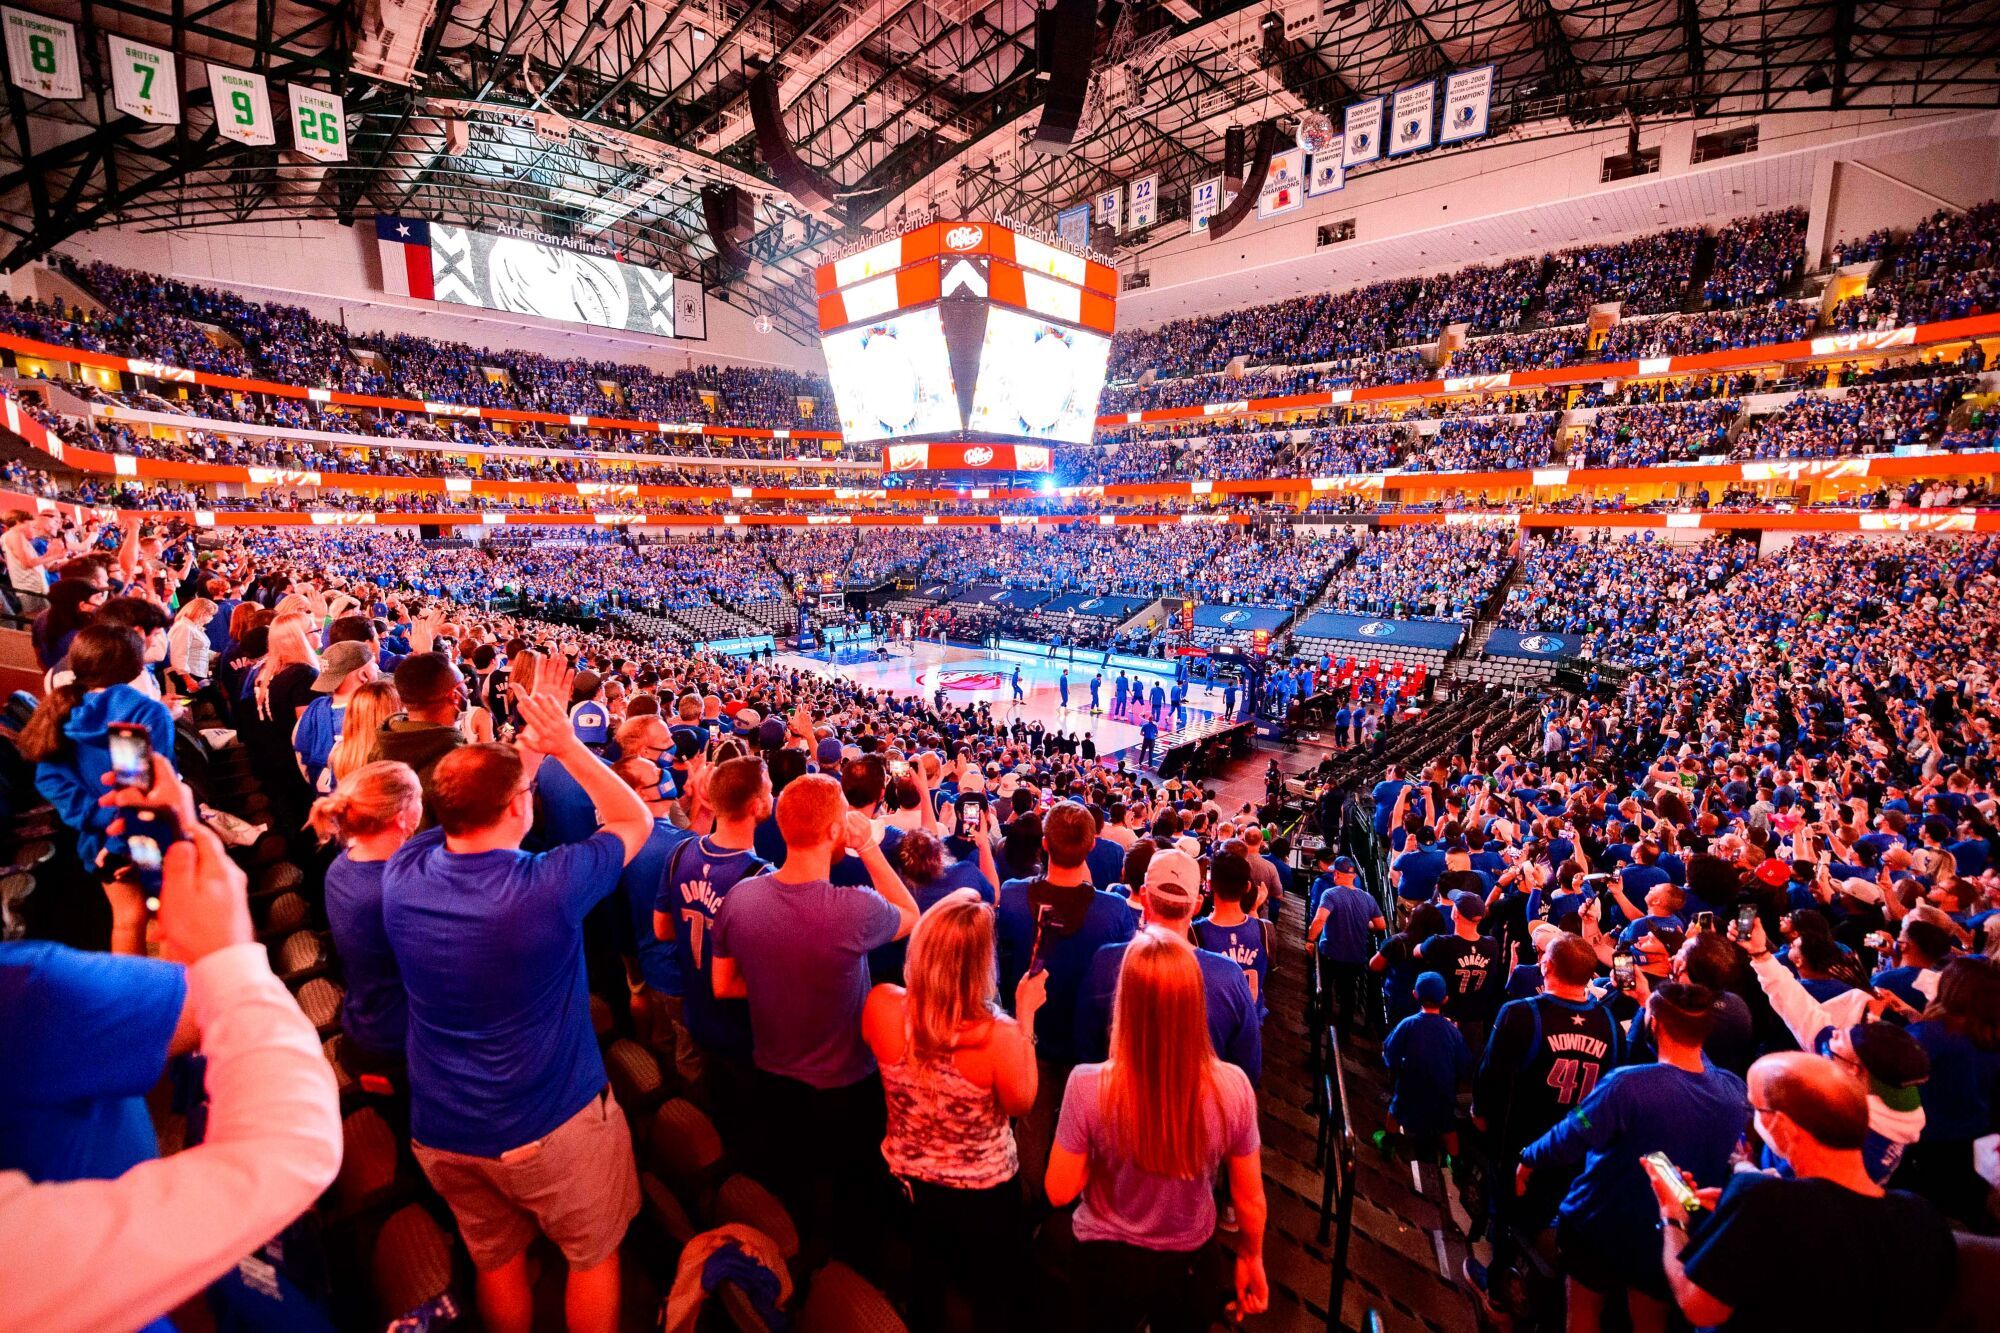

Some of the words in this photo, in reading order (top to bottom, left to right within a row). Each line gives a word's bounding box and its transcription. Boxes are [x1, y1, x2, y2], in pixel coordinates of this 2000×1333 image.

[29, 34, 57, 75] 8
[125, 47, 160, 64] BROTEN
[133, 62, 155, 100] 7
[222, 75, 254, 88] MODANO
[1453, 74, 1486, 89] 2005-2006
[300, 94, 333, 109] LEHTINEN
[1450, 89, 1485, 103] CHAMPIONS
[231, 91, 254, 126] 9
[1397, 104, 1428, 118] CHAMPIONS
[298, 106, 340, 145] 26
[1348, 119, 1377, 132] CHAMPIONS
[1315, 152, 1342, 163] CHAMPIONS
[1136, 180, 1151, 199] 22
[1198, 185, 1213, 201] 12
[1262, 180, 1300, 196] CHAMPIONS
[1102, 194, 1115, 211] 15
[497, 221, 560, 246] American
[561, 235, 608, 256] Airlines
[816, 241, 861, 267] American
[860, 226, 897, 250] Airlines
[895, 207, 937, 236] Center
[994, 208, 1049, 243] American
[1048, 230, 1085, 258] Airlines
[1085, 246, 1117, 269] Center
[681, 907, 715, 970] 7
[1454, 968, 1488, 993] 77
[1546, 1032, 1608, 1060] NOWITZKI
[1546, 1057, 1600, 1105] 41
